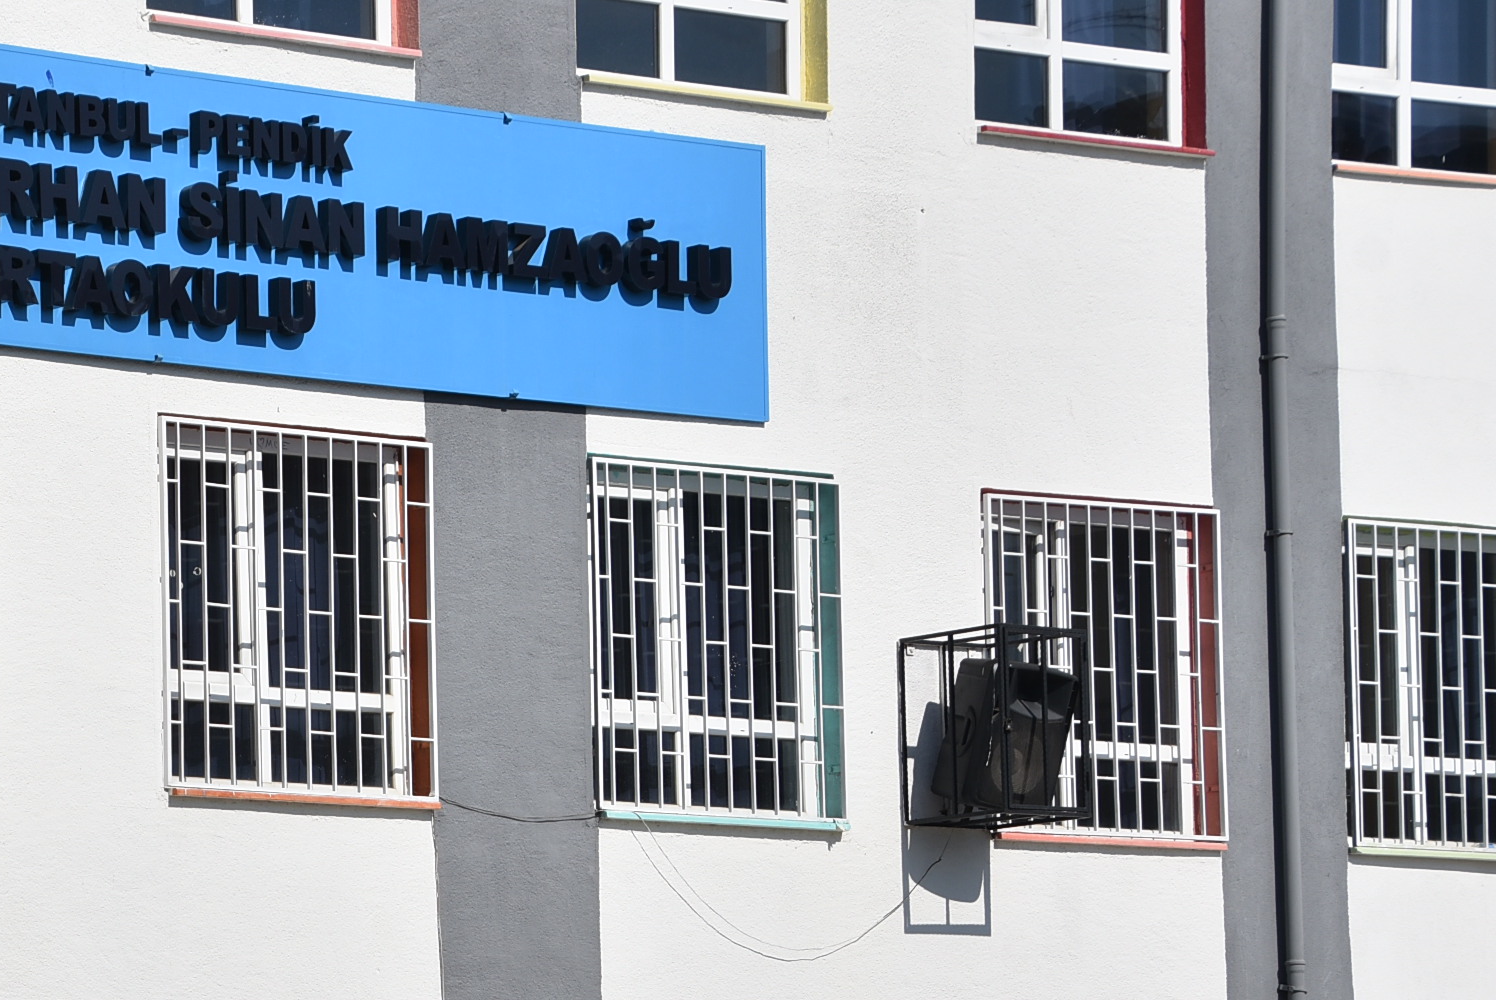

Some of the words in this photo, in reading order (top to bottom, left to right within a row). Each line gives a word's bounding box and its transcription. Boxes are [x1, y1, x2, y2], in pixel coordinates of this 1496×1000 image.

[190, 109, 354, 172] PENDİK
[179, 169, 365, 258] SİNAN
[375, 205, 732, 300] HAMZAOĞLU
